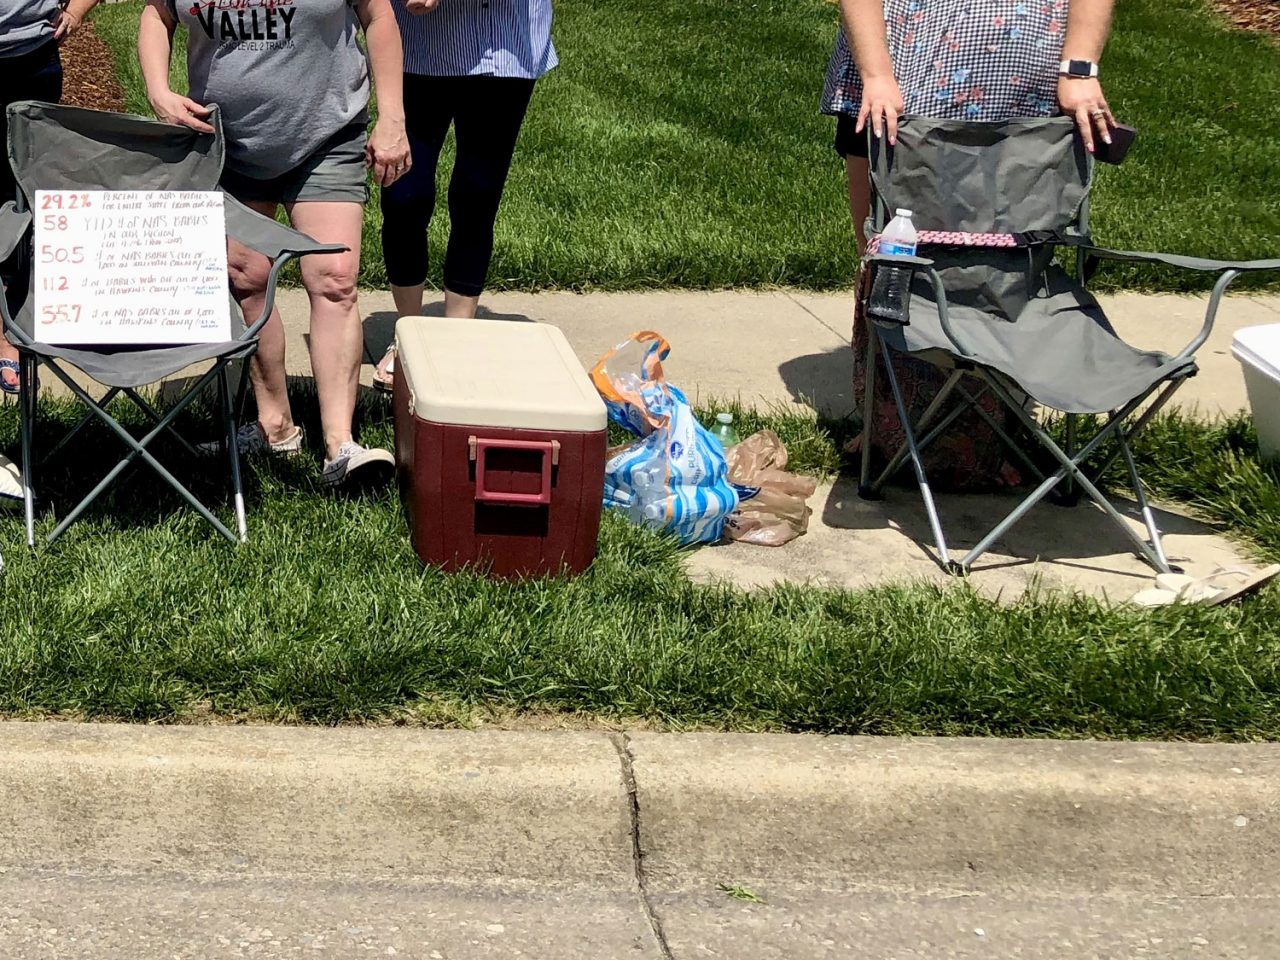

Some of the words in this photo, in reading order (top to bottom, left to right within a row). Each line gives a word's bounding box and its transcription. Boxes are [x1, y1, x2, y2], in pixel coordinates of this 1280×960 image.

[194, 2, 296, 40] VALLEY
[43, 215, 68, 231] 58
[41, 245, 85, 264] 50.5
